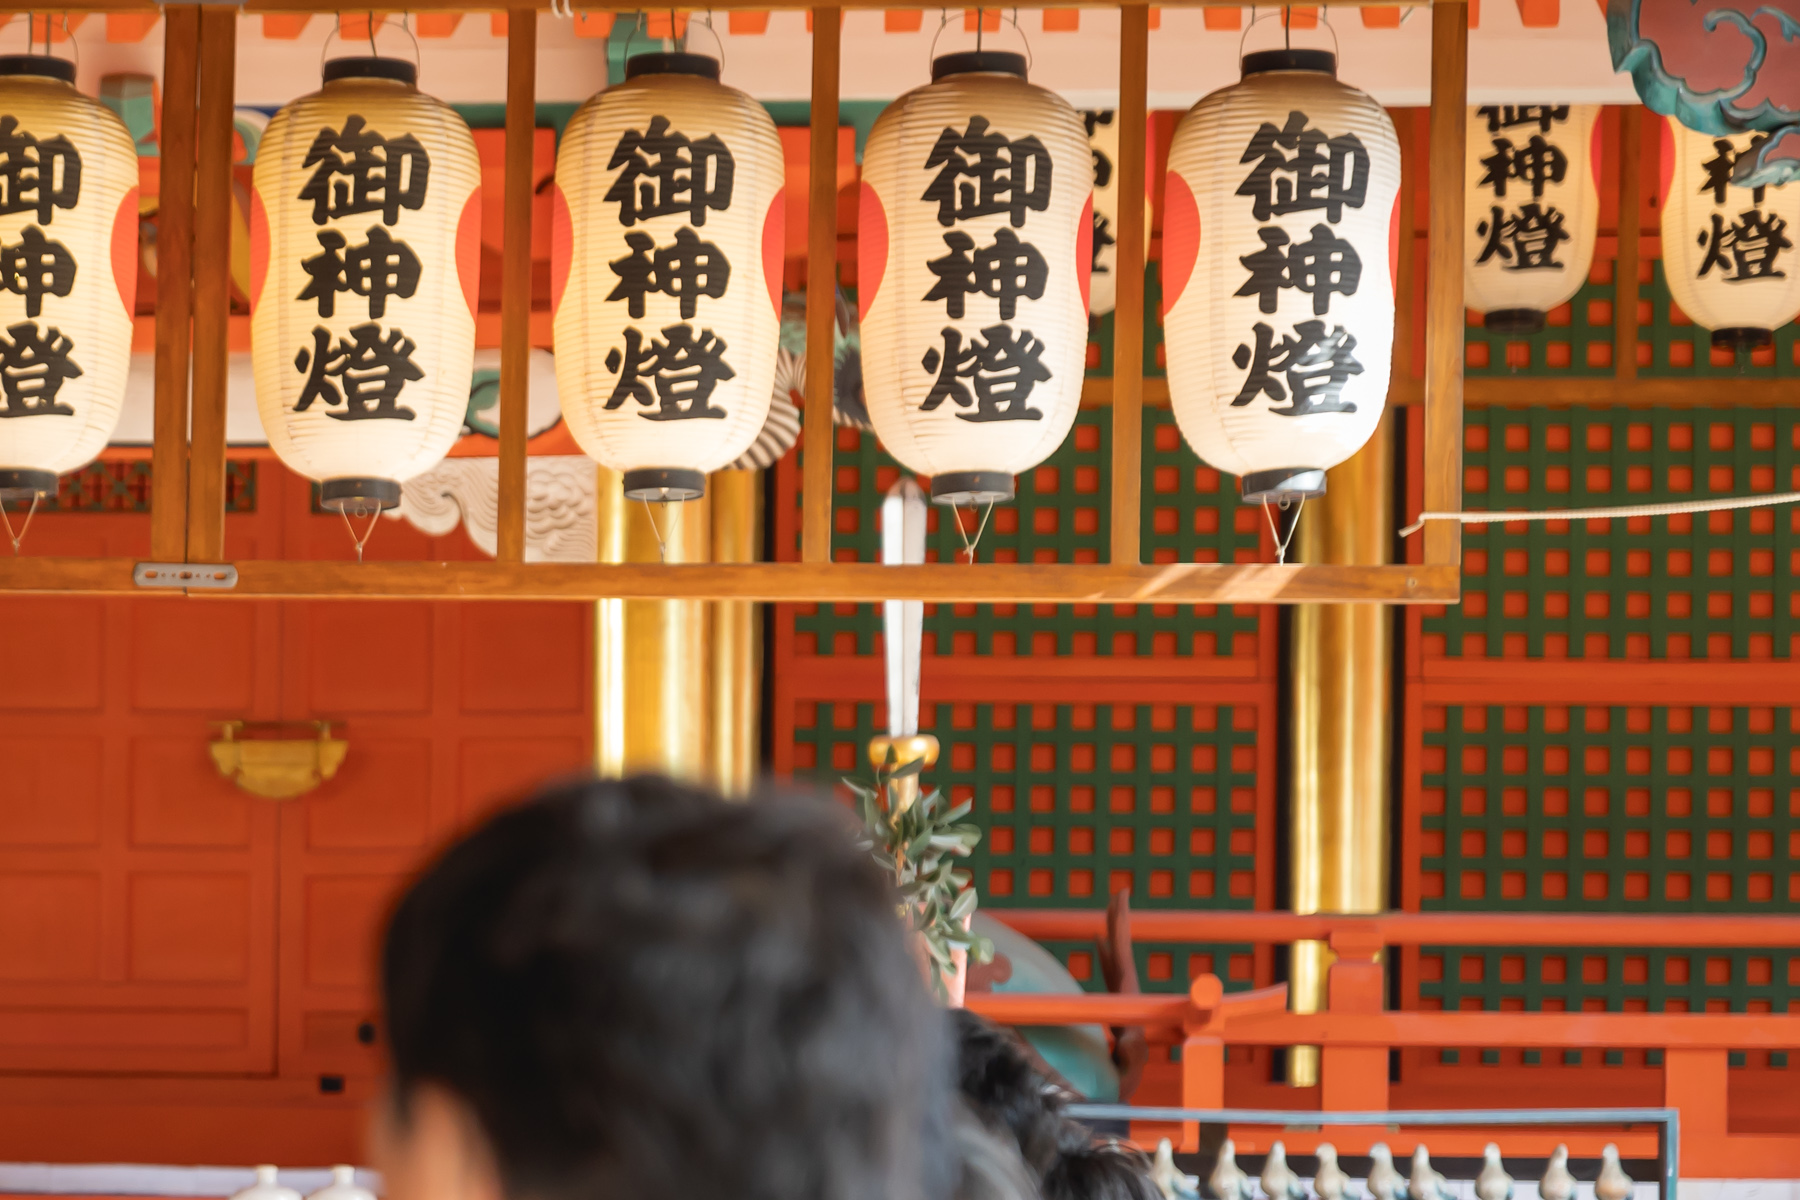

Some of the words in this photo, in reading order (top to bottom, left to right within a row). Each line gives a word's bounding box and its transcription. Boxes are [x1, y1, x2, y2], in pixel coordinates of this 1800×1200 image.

[292, 114, 431, 422] 御神燈
[602, 115, 736, 422] 御神燈
[918, 115, 1054, 424] 御神燈
[1229, 109, 1371, 417] 御神燈
